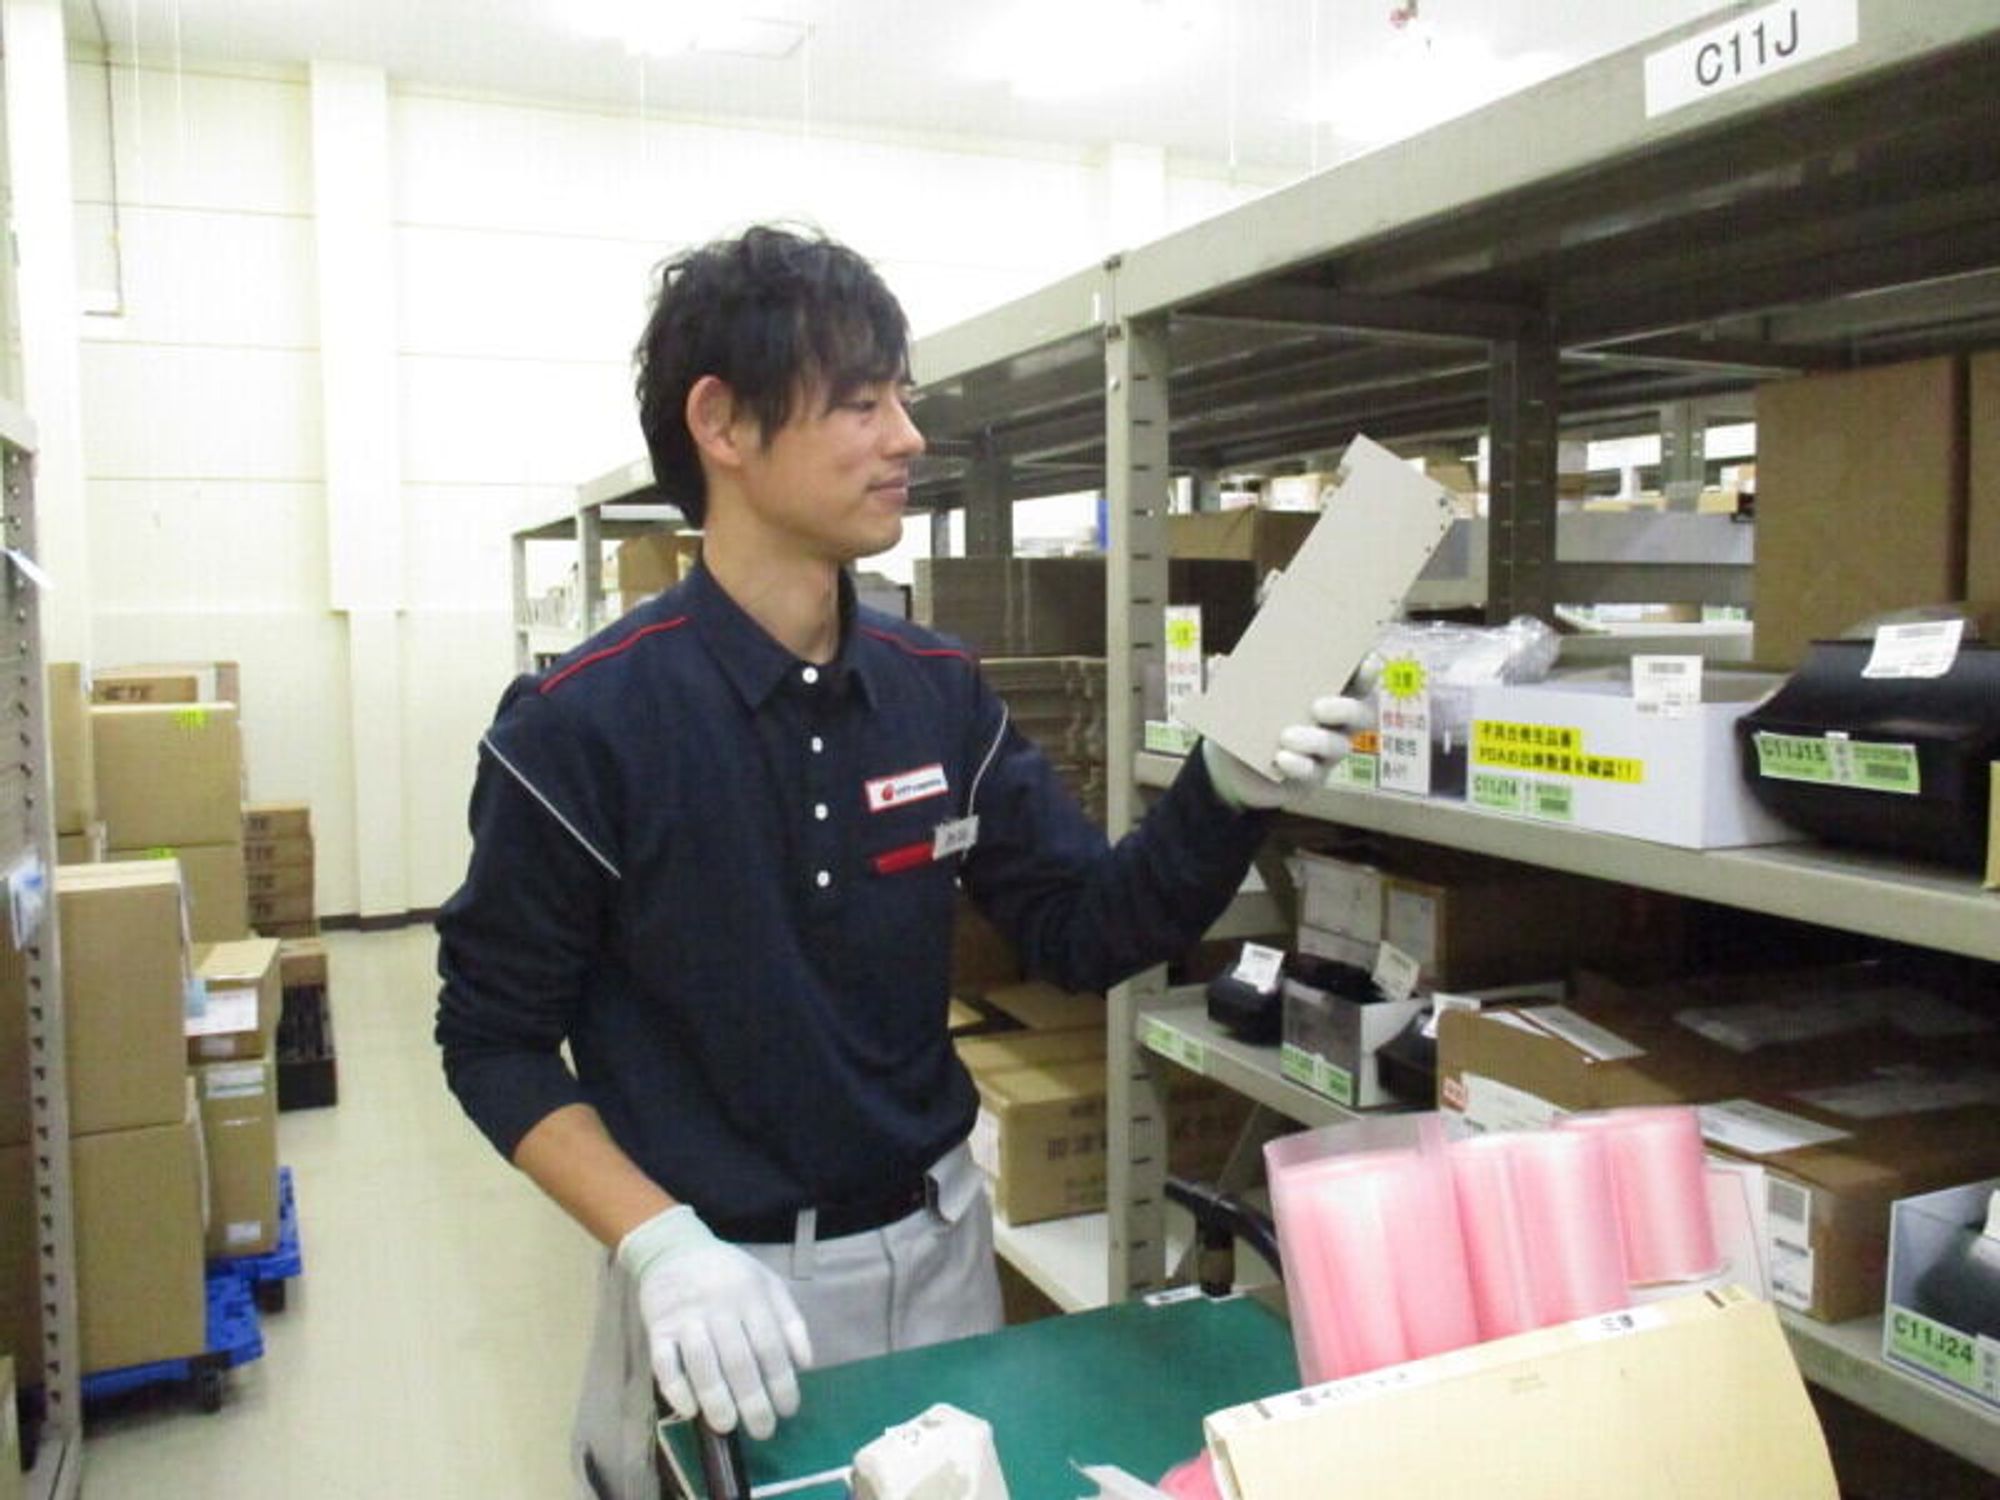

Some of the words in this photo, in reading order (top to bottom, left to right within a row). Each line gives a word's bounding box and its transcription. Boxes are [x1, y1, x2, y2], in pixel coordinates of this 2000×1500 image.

[1696, 9, 1799, 86] C11J
[1760, 739, 1827, 761] C11J15
[1893, 1311, 1974, 1365] C11J24
